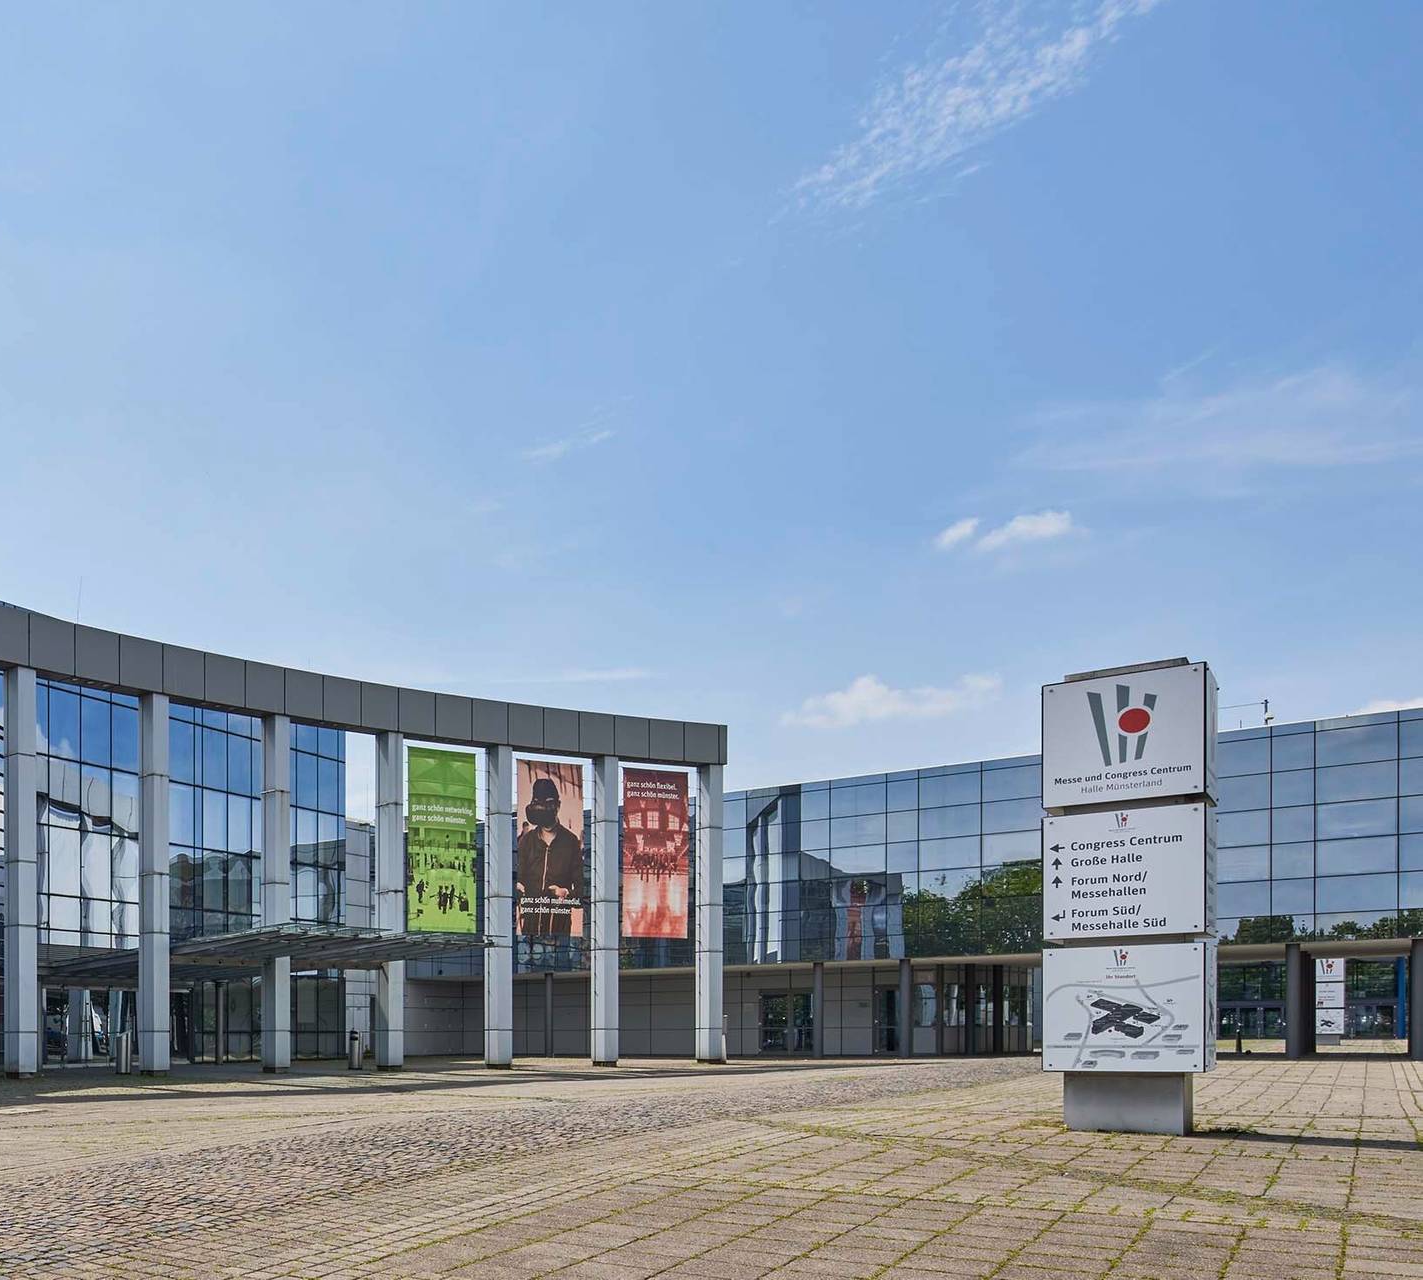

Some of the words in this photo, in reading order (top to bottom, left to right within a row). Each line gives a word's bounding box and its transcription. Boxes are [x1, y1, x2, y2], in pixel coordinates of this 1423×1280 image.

[1085, 773, 1102, 781] und
[1105, 769, 1147, 780] Congress
[1151, 764, 1191, 774] Centrum
[1081, 785, 1103, 794] Halle
[1106, 779, 1162, 791] Münsterland
[445, 816, 466, 824] münster.
[1071, 839, 1125, 851] Congress
[1130, 835, 1182, 845] Centrum
[1071, 856, 1106, 867] Große
[1111, 853, 1142, 864] Halle
[1072, 875, 1108, 886] Forum
[1113, 871, 1147, 883] Nord/
[1072, 887, 1146, 899] Messehallen
[1072, 908, 1108, 917] Forum
[1113, 904, 1141, 916] Süd/
[1072, 920, 1139, 931] Messehalle
[1143, 917, 1166, 928] Süd
